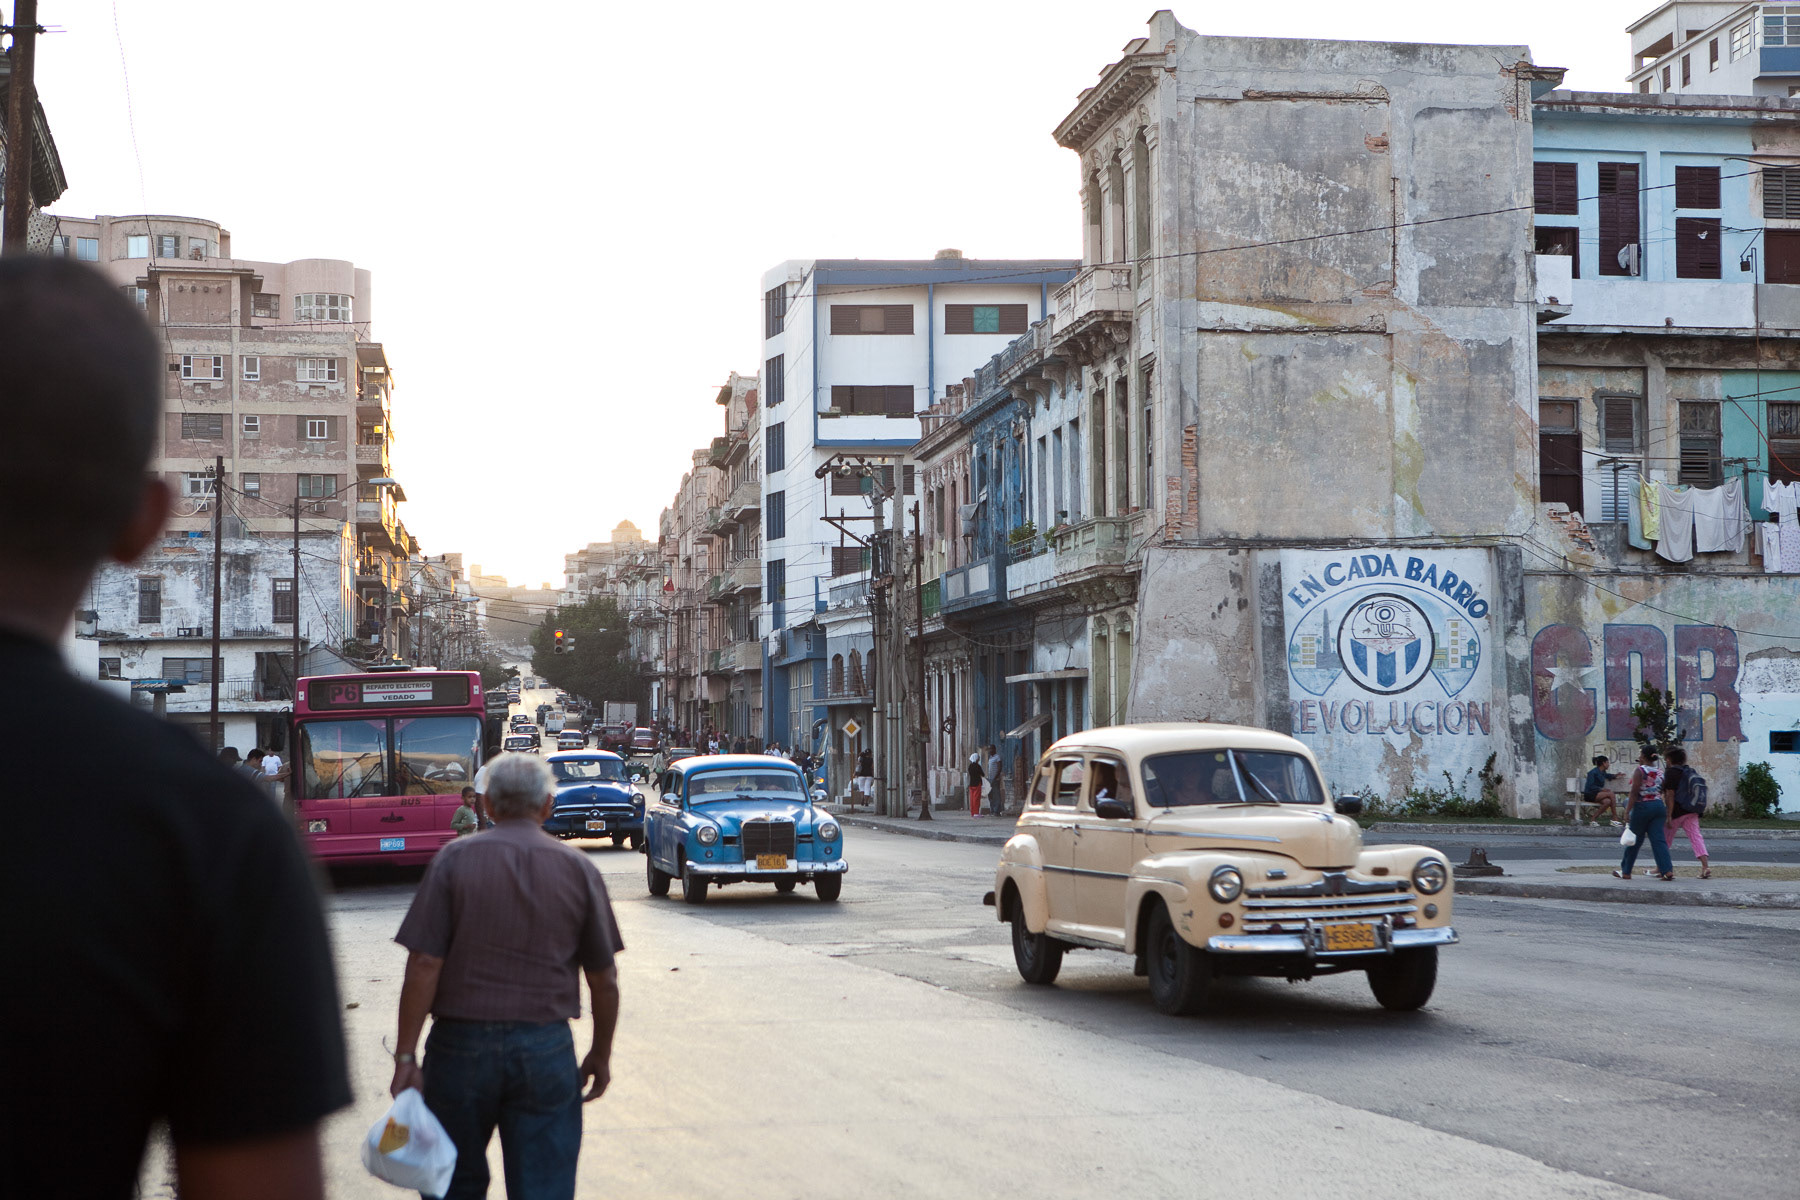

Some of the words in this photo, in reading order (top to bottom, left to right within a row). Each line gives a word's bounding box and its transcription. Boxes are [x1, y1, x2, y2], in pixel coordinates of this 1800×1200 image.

[1288, 574, 1326, 609] EN
[1323, 553, 1399, 587] CADA
[1404, 556, 1489, 619] BARRIO
[1531, 623, 1749, 742] CDR
[330, 685, 357, 703] P6
[1592, 743, 1640, 765] FDEL
[401, 798, 421, 806] BUS
